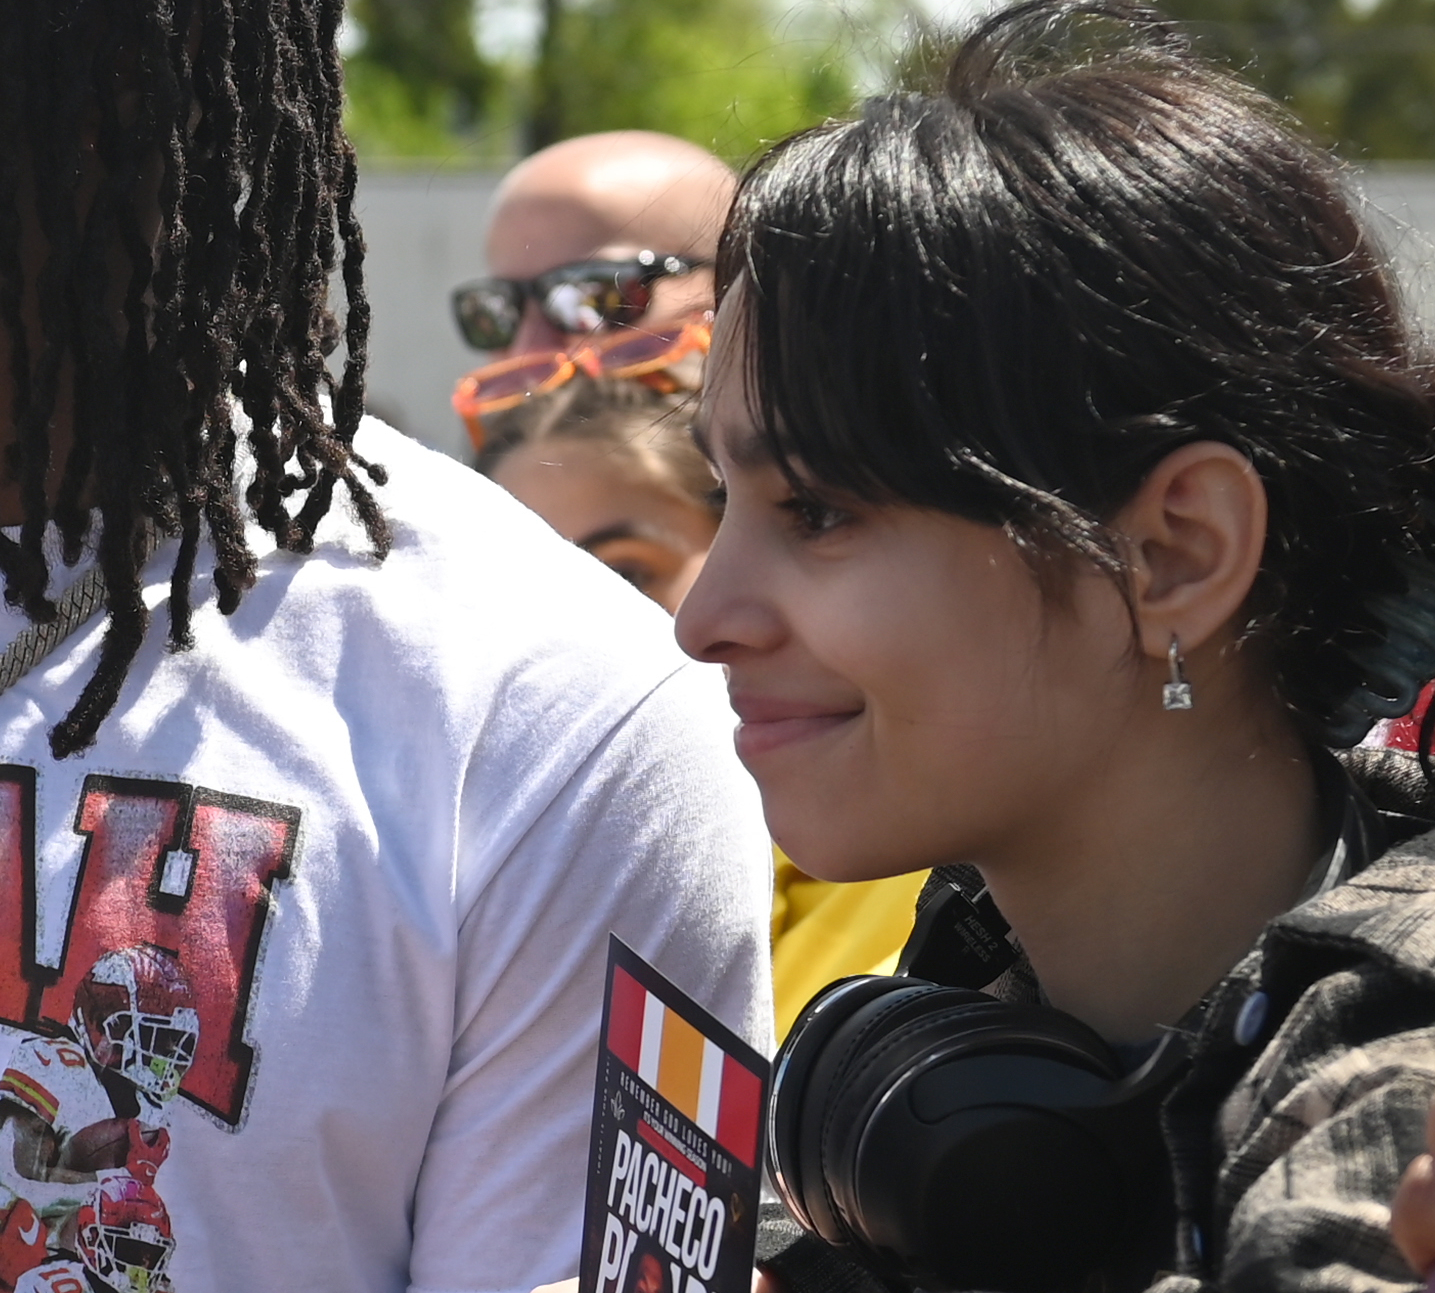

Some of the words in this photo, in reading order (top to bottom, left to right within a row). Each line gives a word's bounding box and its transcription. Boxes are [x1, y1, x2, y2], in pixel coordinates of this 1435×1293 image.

[954, 921, 991, 963] WIRELESS
[964, 915, 992, 943] HESH
[988, 941, 999, 952] 2
[619, 1071, 660, 1118] REMEMBER
[663, 1109, 680, 1134] GOD
[681, 1124, 709, 1159] LOVES
[711, 1149, 733, 1178] YOU!
[607, 1129, 726, 1281] PACHECO
